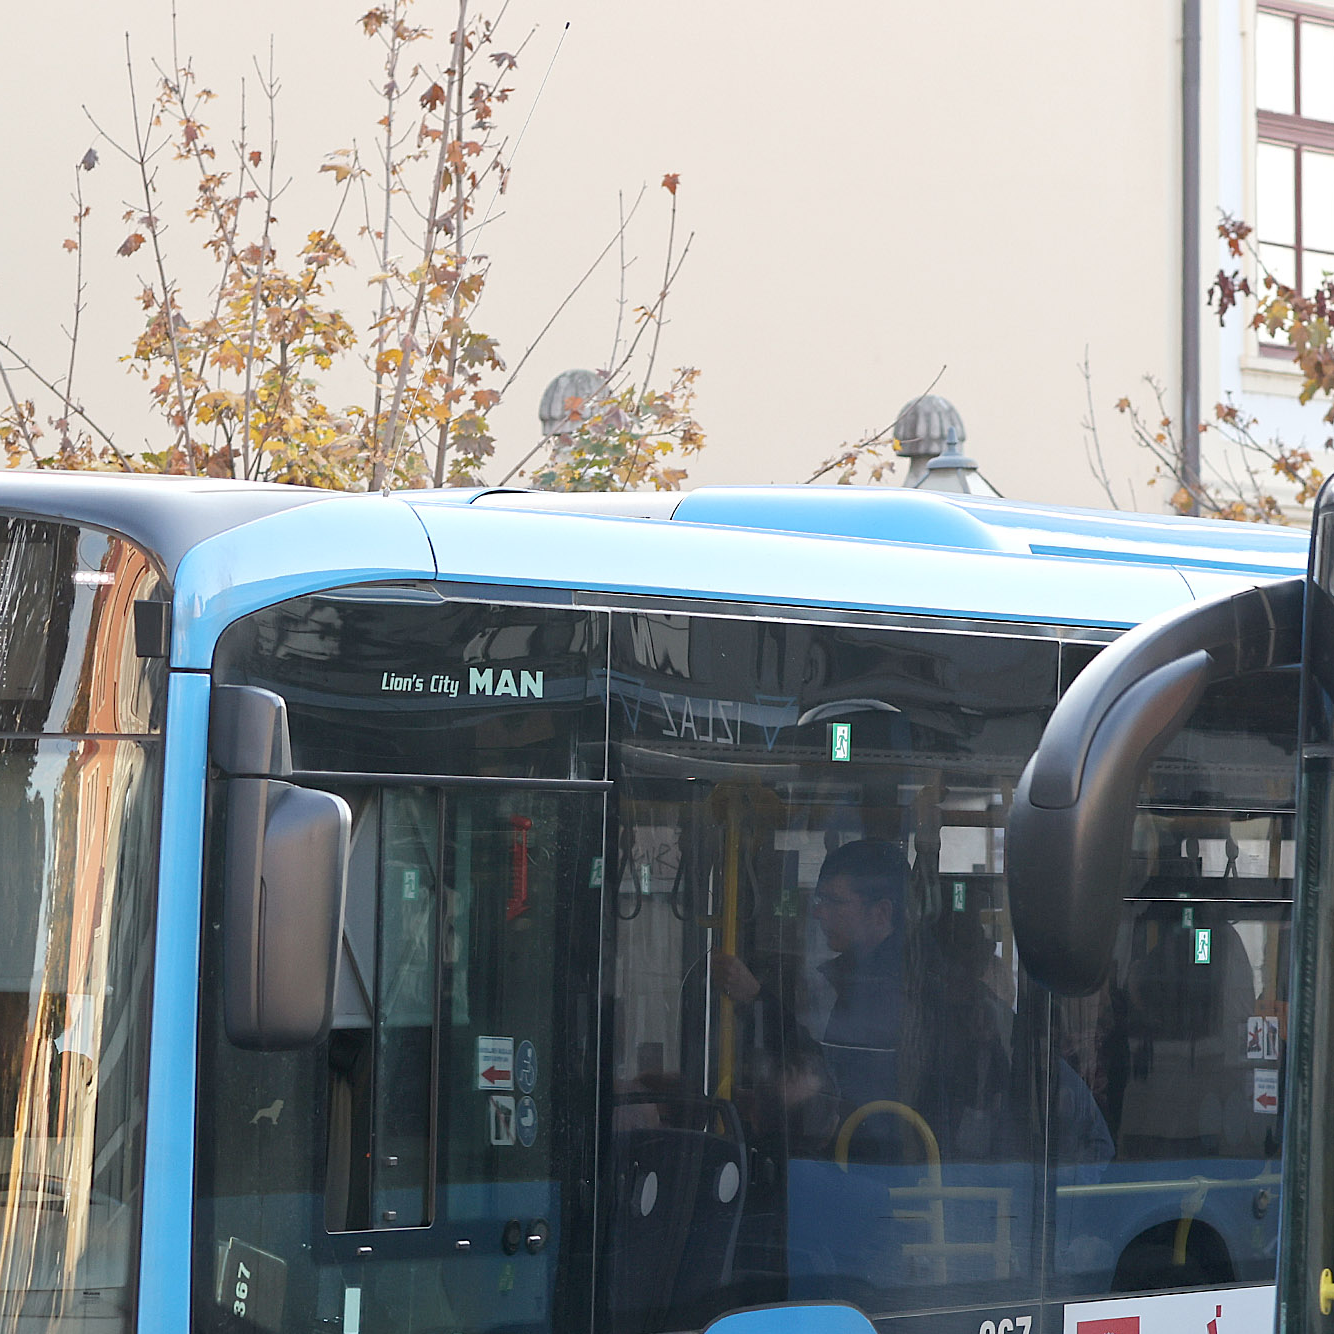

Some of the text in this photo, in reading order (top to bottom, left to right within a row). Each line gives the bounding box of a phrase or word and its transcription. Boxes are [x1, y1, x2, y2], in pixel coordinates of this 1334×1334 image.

[381, 667, 544, 698] Lion's City MAN
[233, 1261, 252, 1318] 367
